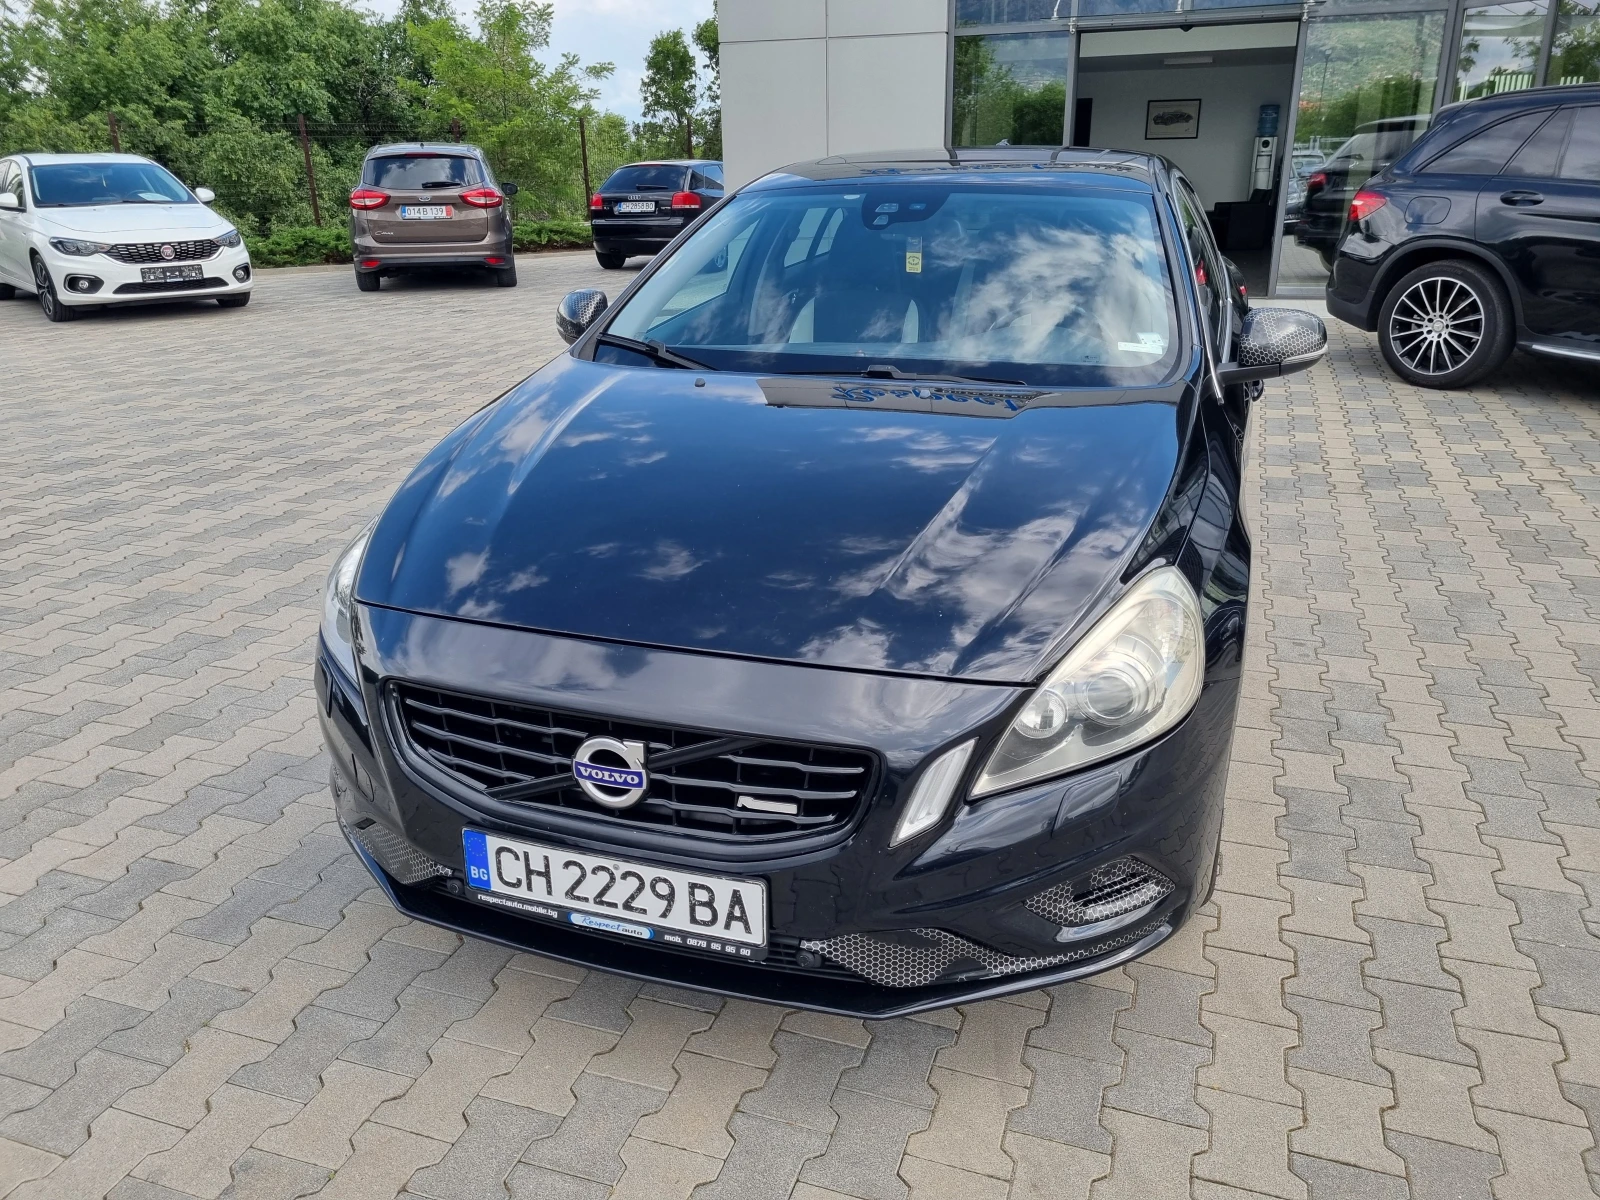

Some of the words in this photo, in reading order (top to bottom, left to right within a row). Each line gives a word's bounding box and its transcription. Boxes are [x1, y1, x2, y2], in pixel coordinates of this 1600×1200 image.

[577, 765, 640, 785] VOLVO
[470, 866, 488, 881] BG
[495, 846, 553, 896] CH
[562, 860, 676, 919] 2229
[688, 882, 753, 935] BA
[477, 893, 558, 919] respectauto.mobile.bg
[664, 934, 683, 944] mob.
[686, 938, 707, 948] 0879
[710, 941, 722, 951] 95
[725, 945, 736, 954] 95
[739, 948, 751, 957] 90
